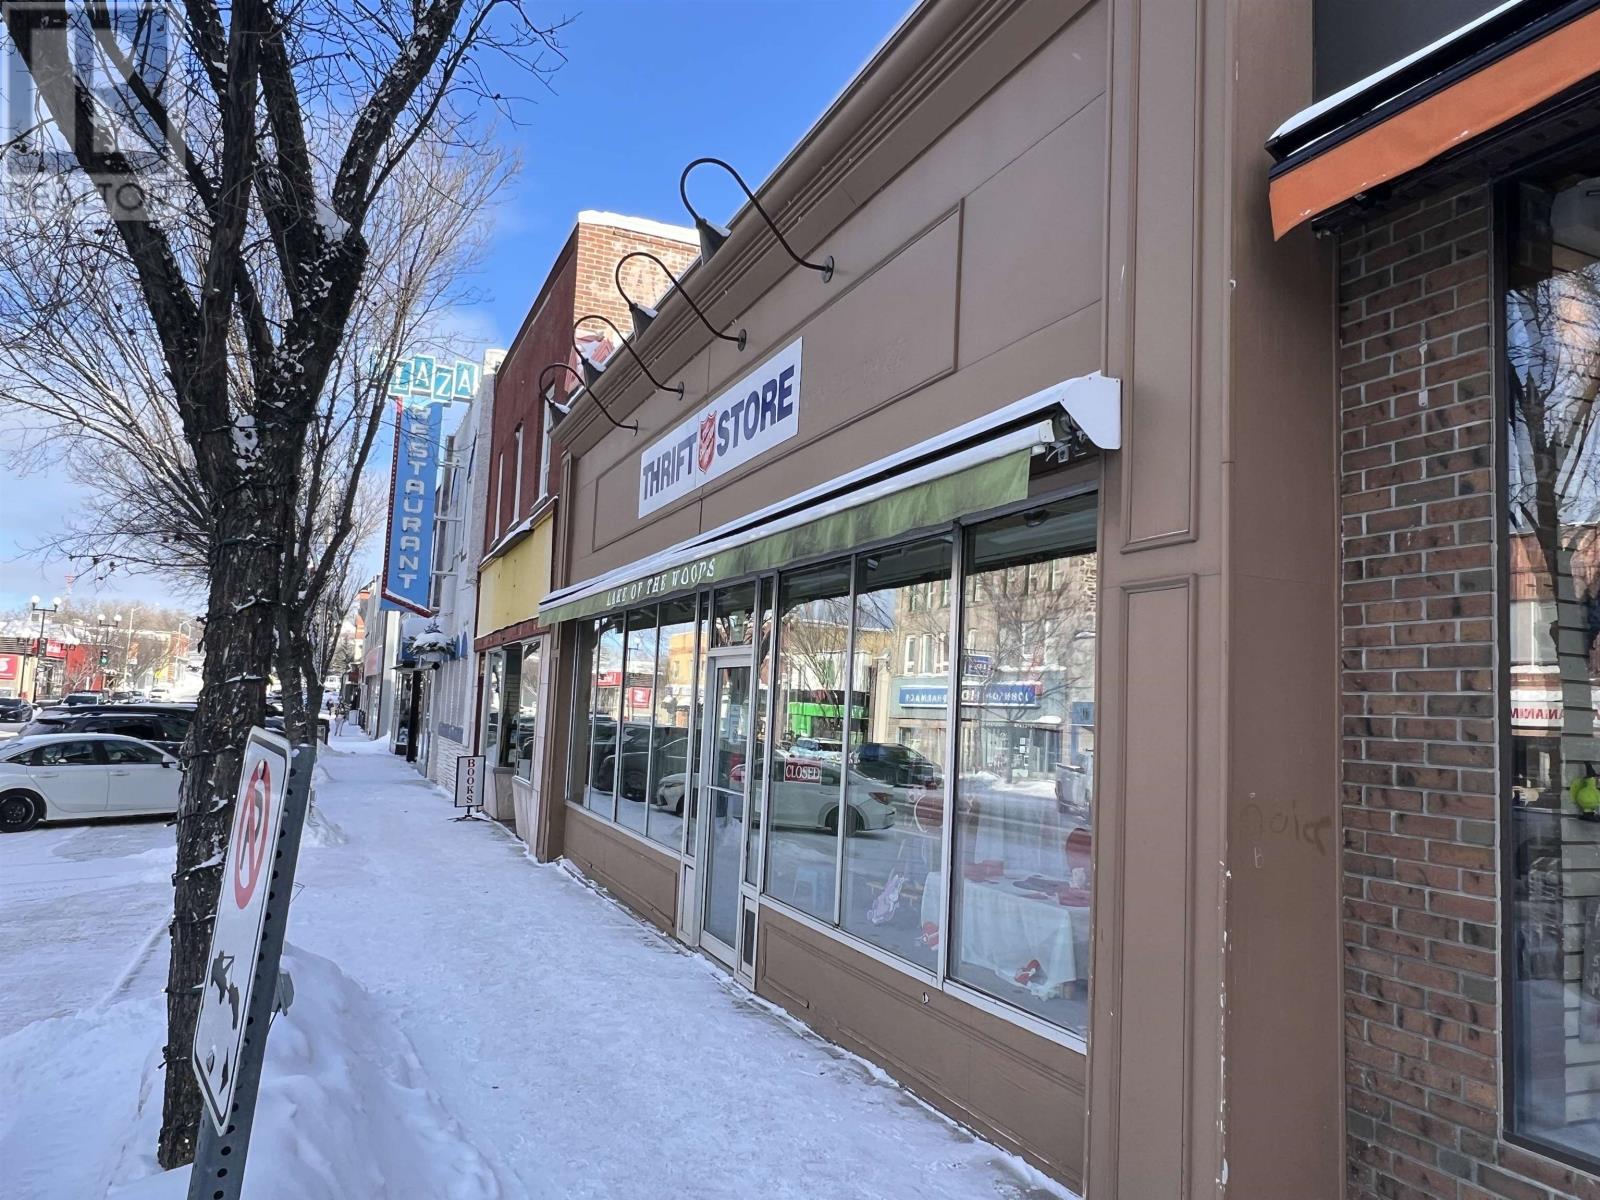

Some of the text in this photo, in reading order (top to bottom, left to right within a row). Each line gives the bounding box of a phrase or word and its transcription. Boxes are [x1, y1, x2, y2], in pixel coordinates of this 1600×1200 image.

[642, 431, 698, 501] THRIFT
[716, 364, 795, 457] STORE
[399, 402, 431, 589] RESTAURANT
[606, 586, 627, 607] LAKE
[630, 581, 643, 600] OF
[646, 573, 668, 595] THE
[466, 758, 476, 804] BOOKS
[785, 765, 820, 780] CLOSED
